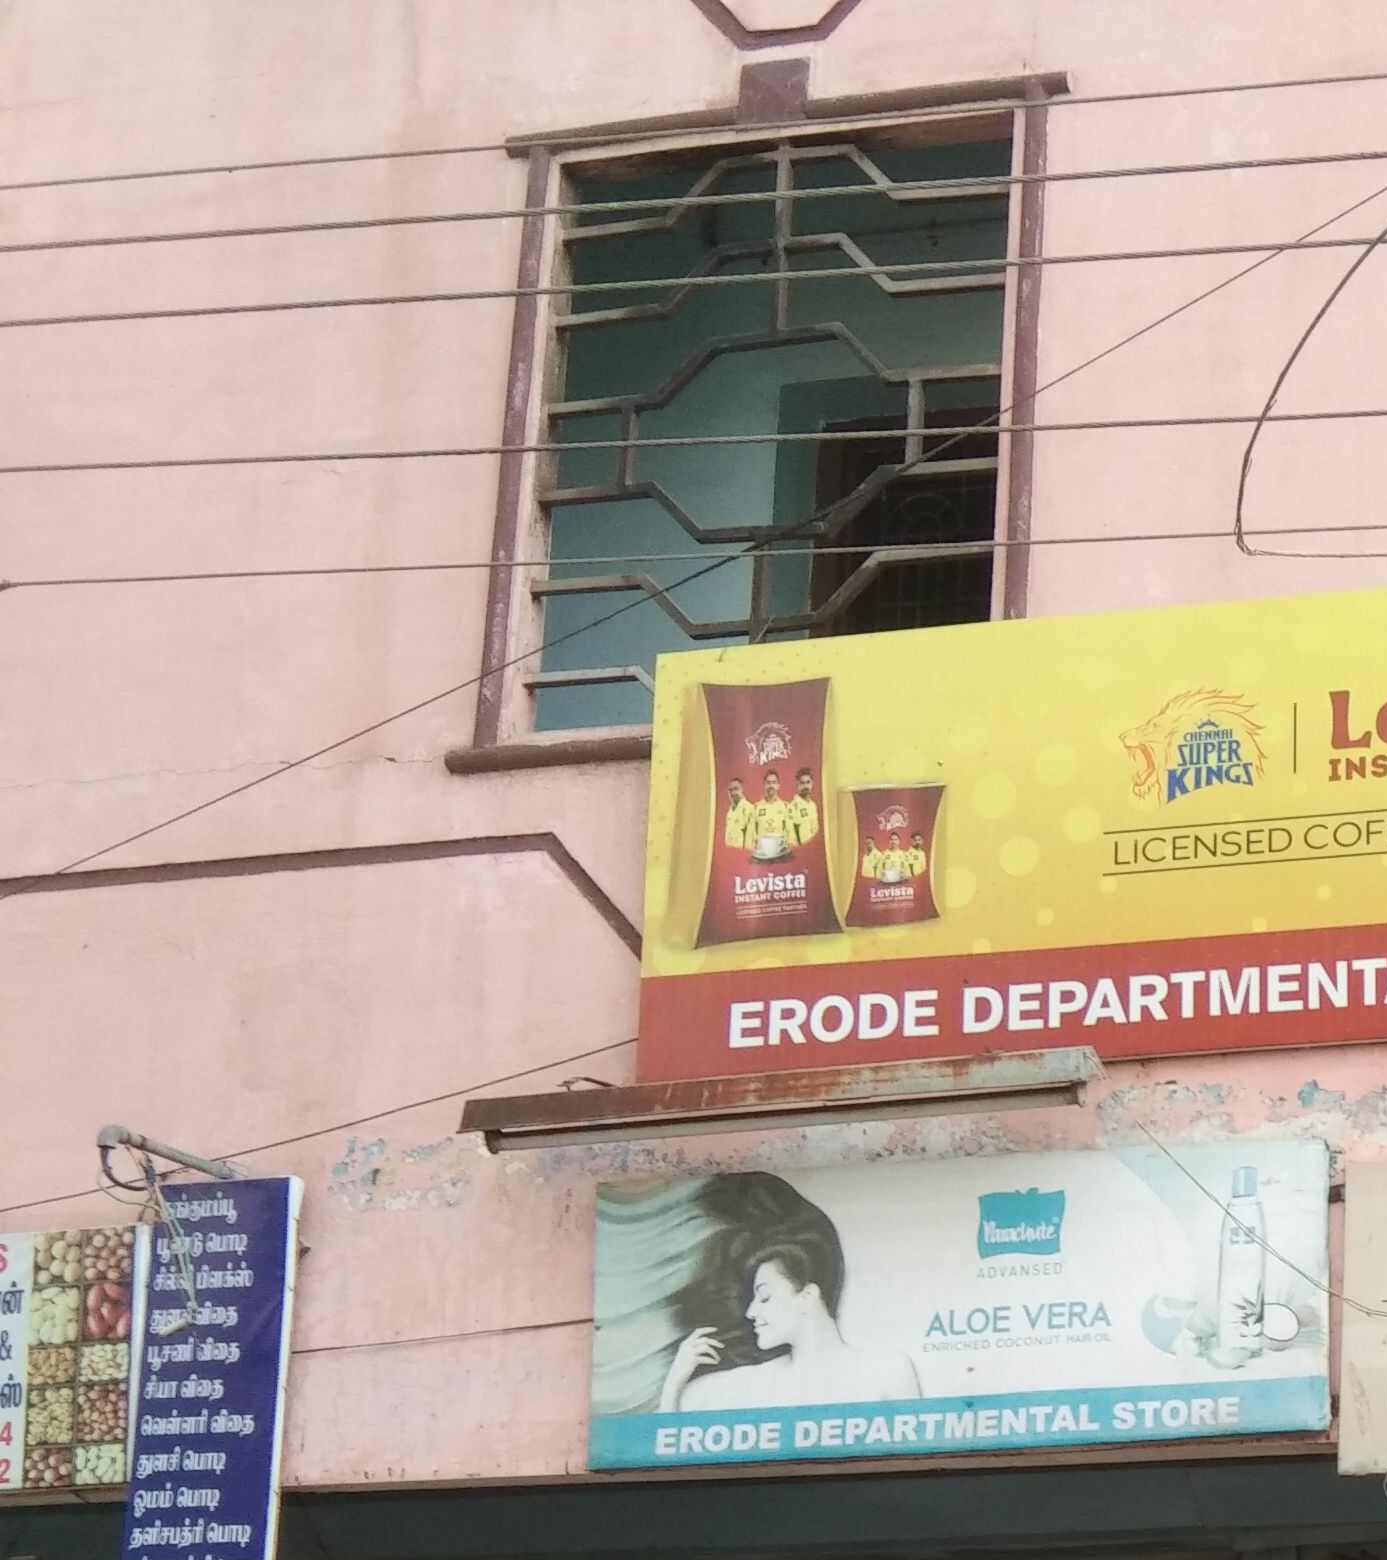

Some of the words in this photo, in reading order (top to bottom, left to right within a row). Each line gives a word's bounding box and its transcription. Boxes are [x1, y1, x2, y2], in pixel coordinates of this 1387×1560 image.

[1183, 728, 1233, 743] CHENNAI
[1177, 742, 1242, 767] SUPER
[1167, 762, 1254, 804] KINGS
[1113, 827, 1293, 865] LICENSED
[735, 873, 806, 894] Levista
[729, 992, 938, 1049] ERODE
[976, 1263, 1063, 1279] ADVANSED
[925, 1306, 1010, 1337] ALOE
[1023, 1302, 1111, 1329] VERA
[923, 1340, 990, 1353] ENRICHED
[996, 1335, 1061, 1348] COCONUT
[1066, 1333, 1091, 1343] HAIR
[655, 1419, 780, 1456] ERODE
[801, 1404, 1099, 1446] DEPARTMENTAL
[1112, 1396, 1240, 1431] STORE
[183, 1448, 226, 1475] பொடி
[178, 1486, 220, 1512] பொடி
[206, 1521, 251, 1547] பொடி
